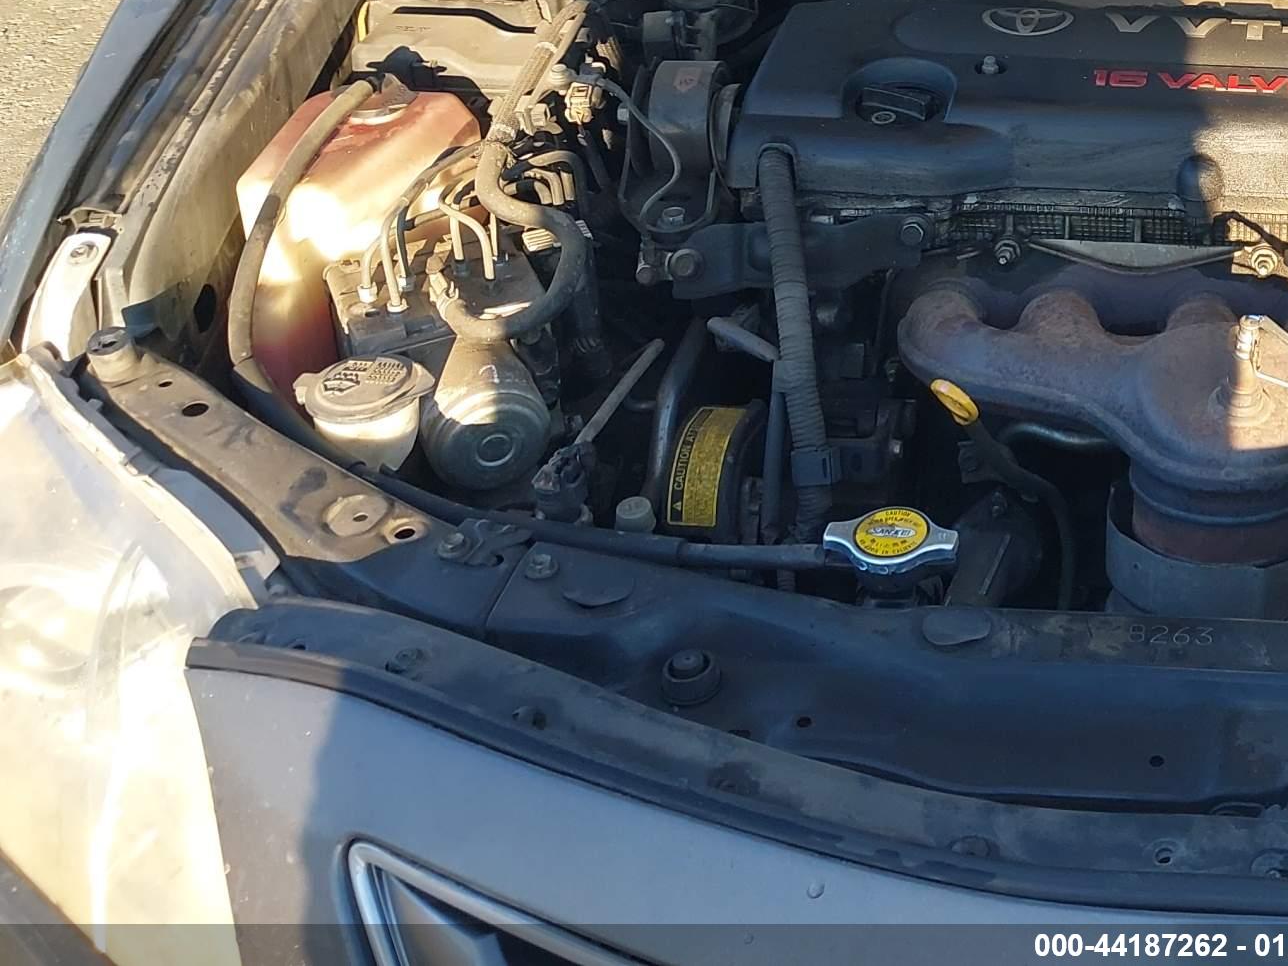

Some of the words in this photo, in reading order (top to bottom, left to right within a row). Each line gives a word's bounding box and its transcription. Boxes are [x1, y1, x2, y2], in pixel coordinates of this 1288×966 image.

[1094, 67, 1149, 88] 16
[674, 445, 691, 491] CAUTION
[1128, 623, 1214, 646] 8263
